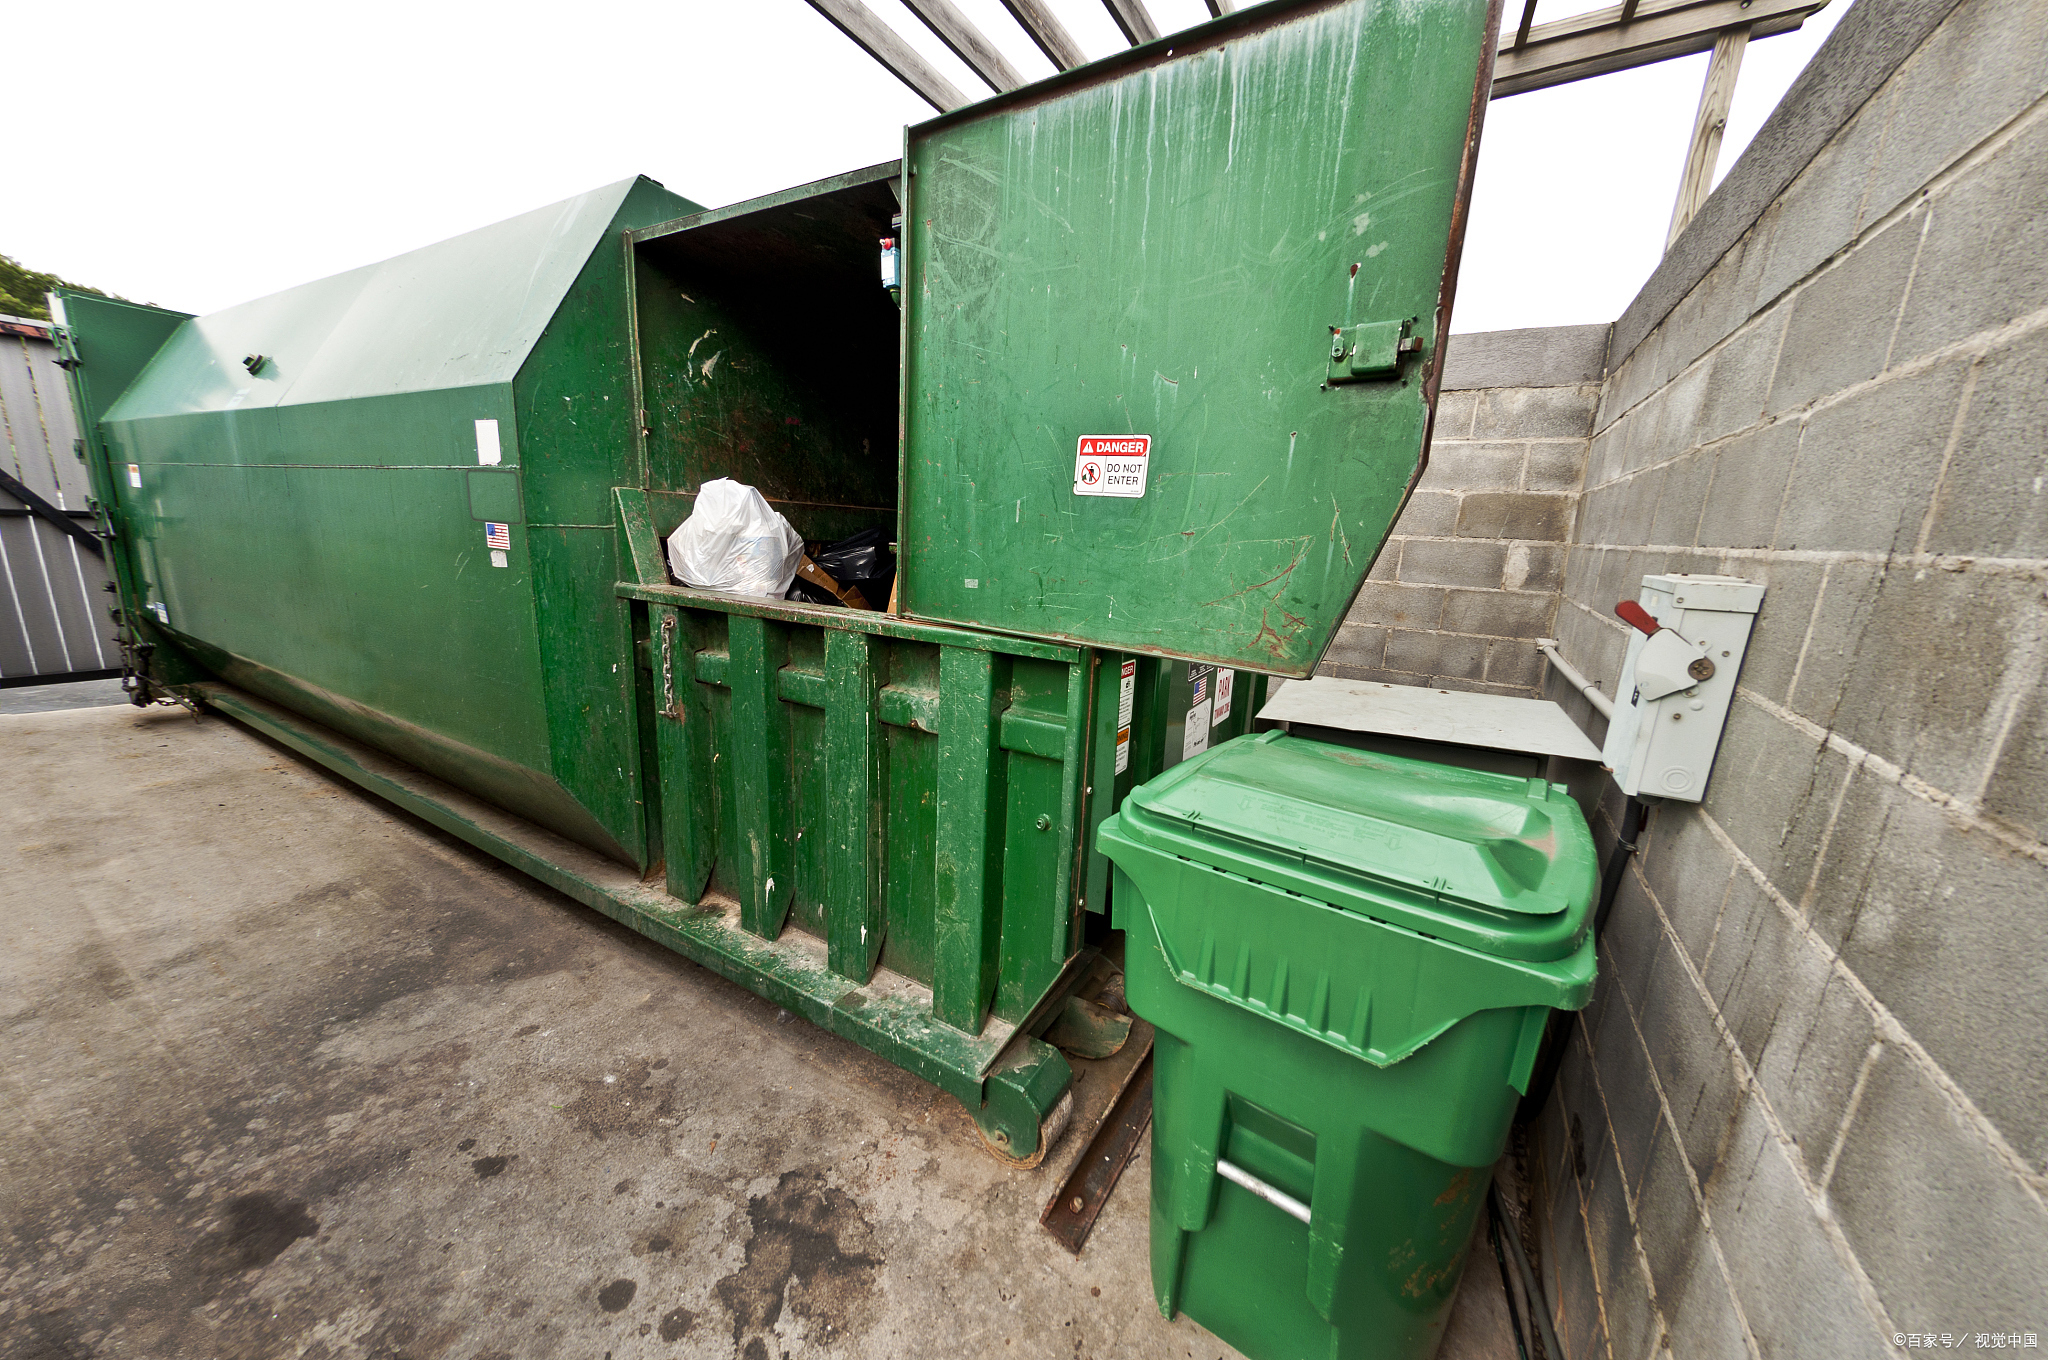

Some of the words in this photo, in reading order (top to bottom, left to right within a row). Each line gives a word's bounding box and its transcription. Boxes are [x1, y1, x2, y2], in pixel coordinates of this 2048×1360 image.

[1096, 441, 1144, 453] DANGER
[1107, 463, 1120, 473] DO
[1123, 463, 1142, 473] NOT
[1107, 475, 1139, 485] ENTER
[1121, 665, 1133, 676] NGER
